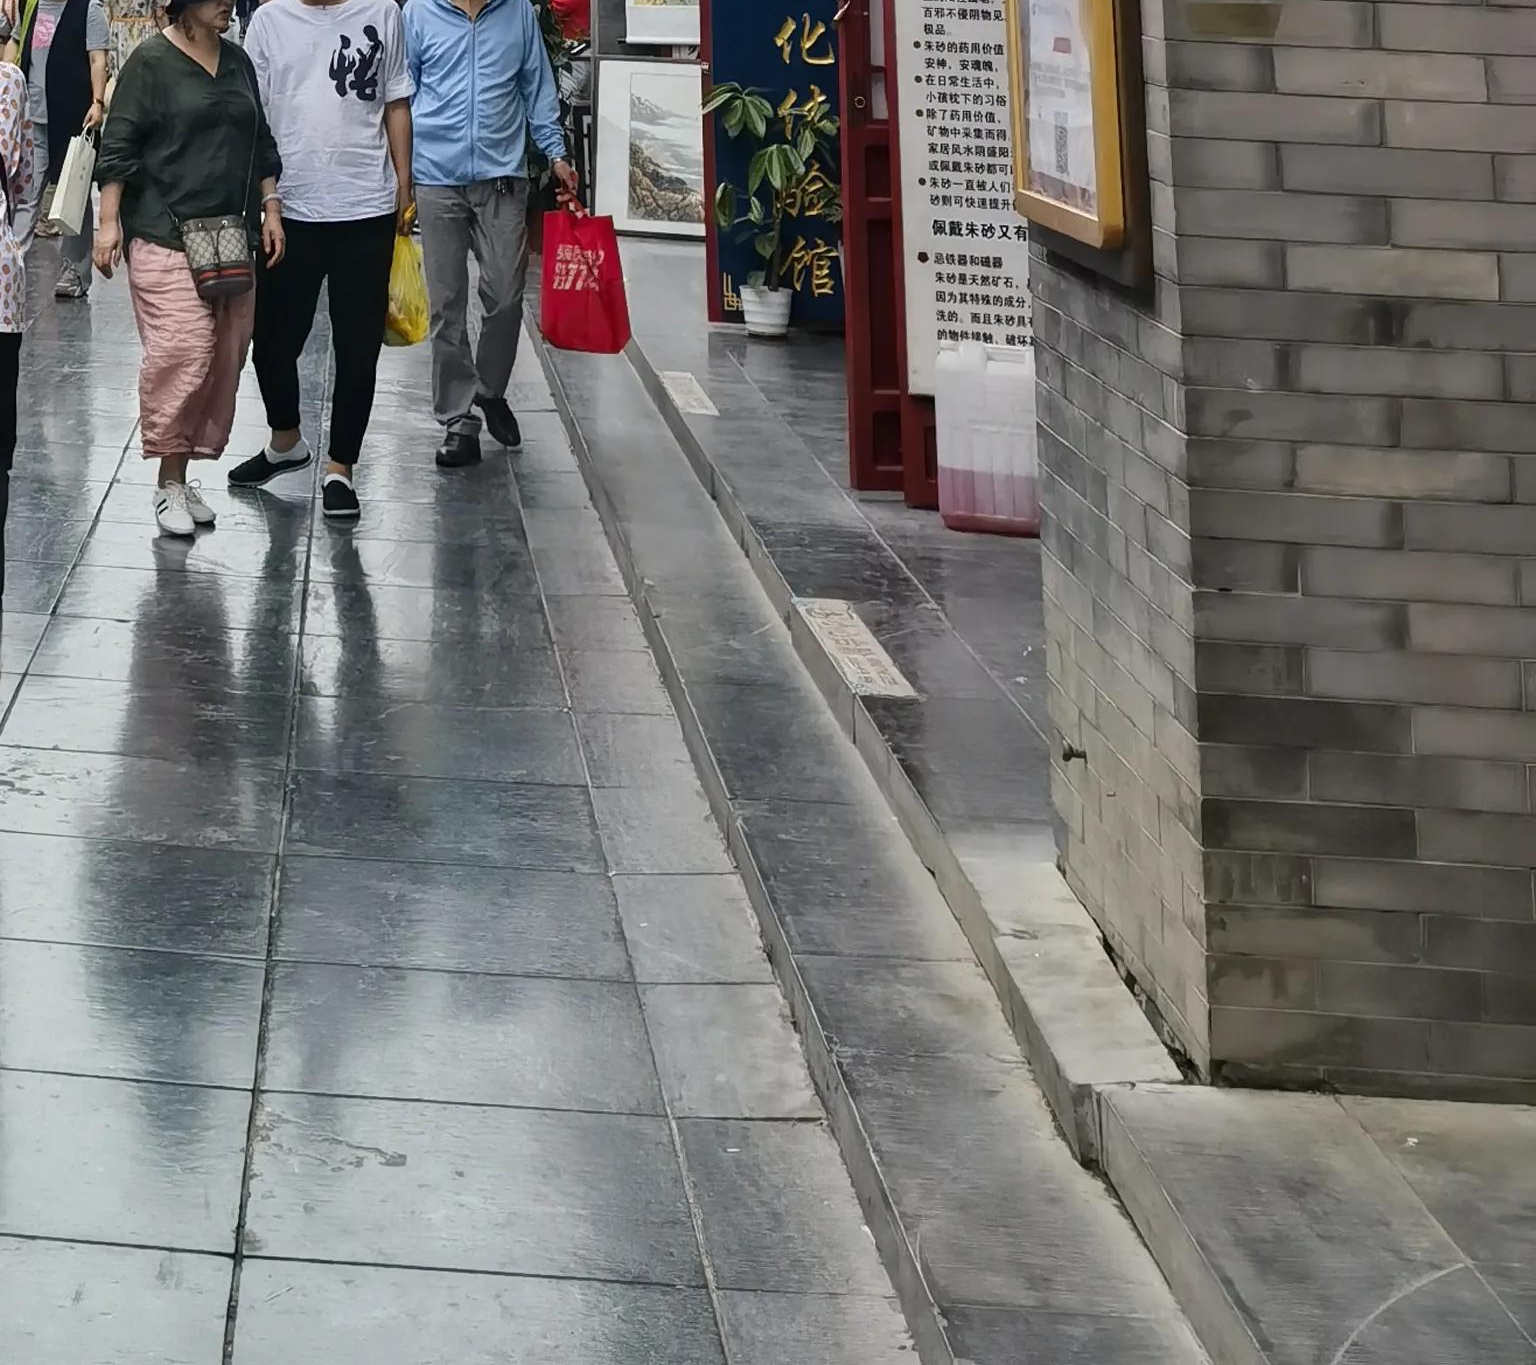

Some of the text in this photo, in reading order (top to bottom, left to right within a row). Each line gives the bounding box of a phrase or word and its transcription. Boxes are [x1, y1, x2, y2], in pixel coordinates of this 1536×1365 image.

[928, 142, 1014, 158] 家居风水阴盛阳
[929, 177, 1014, 194] 朱砂一直被人们
